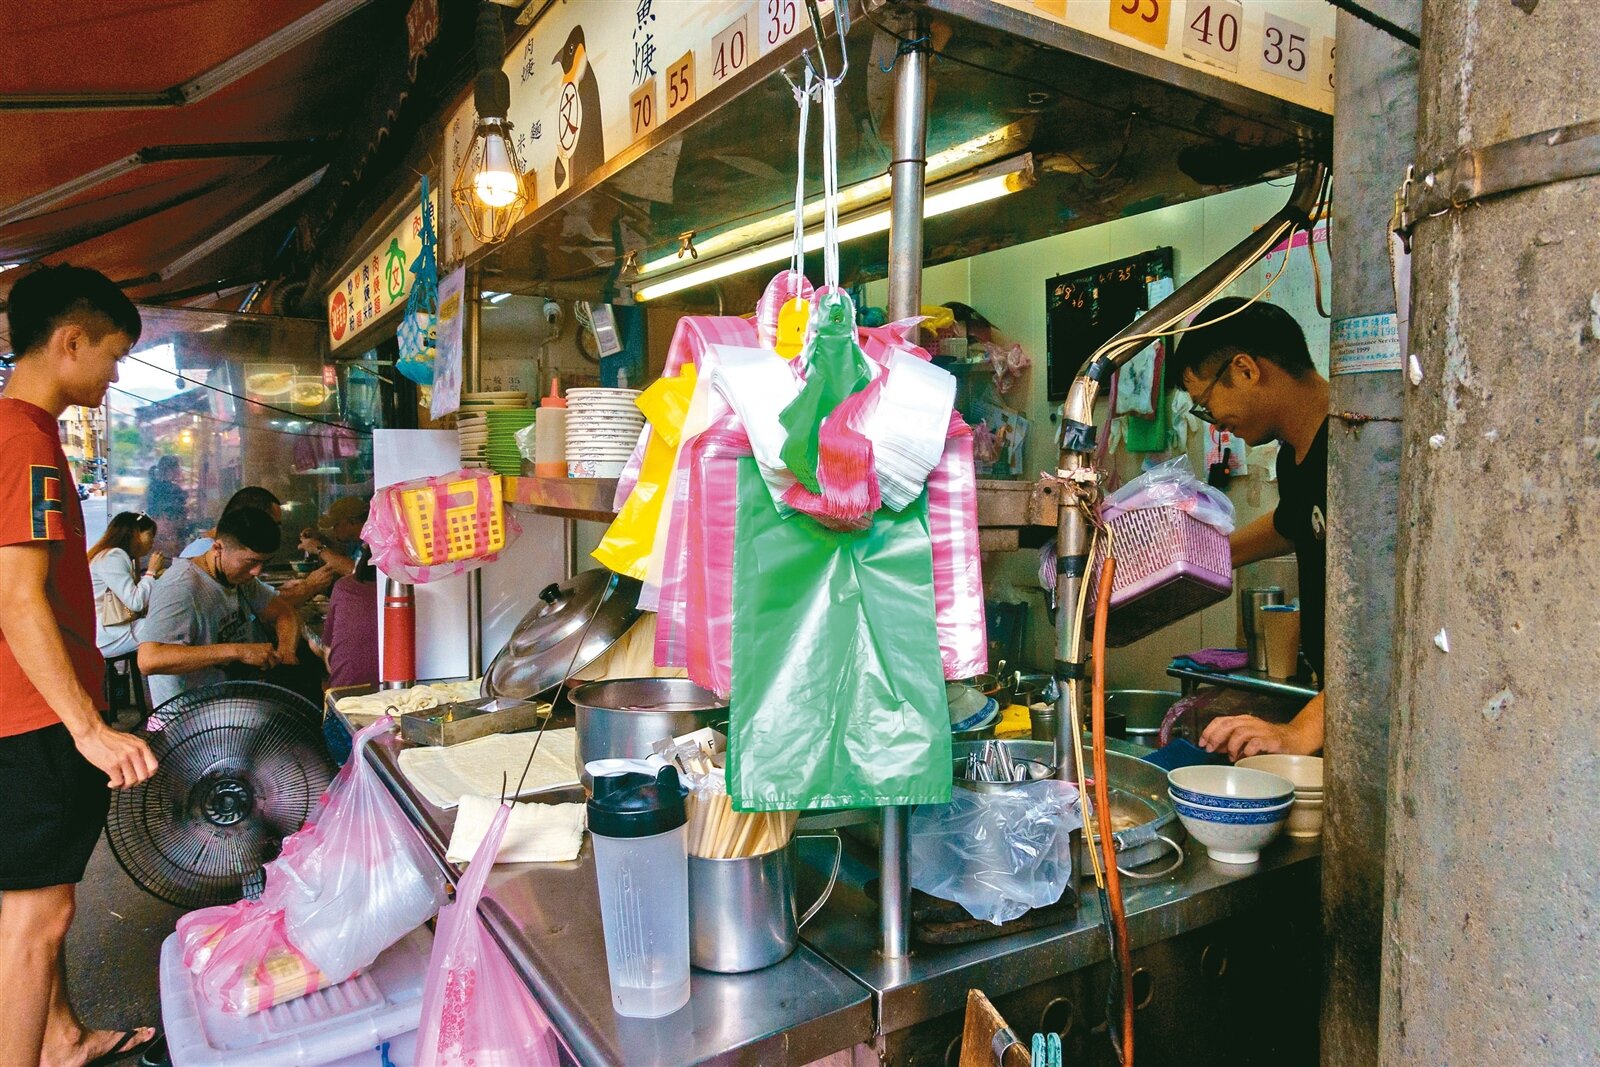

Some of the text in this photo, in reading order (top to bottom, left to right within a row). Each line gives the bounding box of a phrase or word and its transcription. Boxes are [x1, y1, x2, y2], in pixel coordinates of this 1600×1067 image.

[768, 0, 796, 44] 35
[1190, 5, 1238, 52] 40
[713, 30, 745, 80] 40
[1264, 27, 1306, 72] 35
[669, 63, 689, 108] 55
[633, 94, 652, 133] 70
